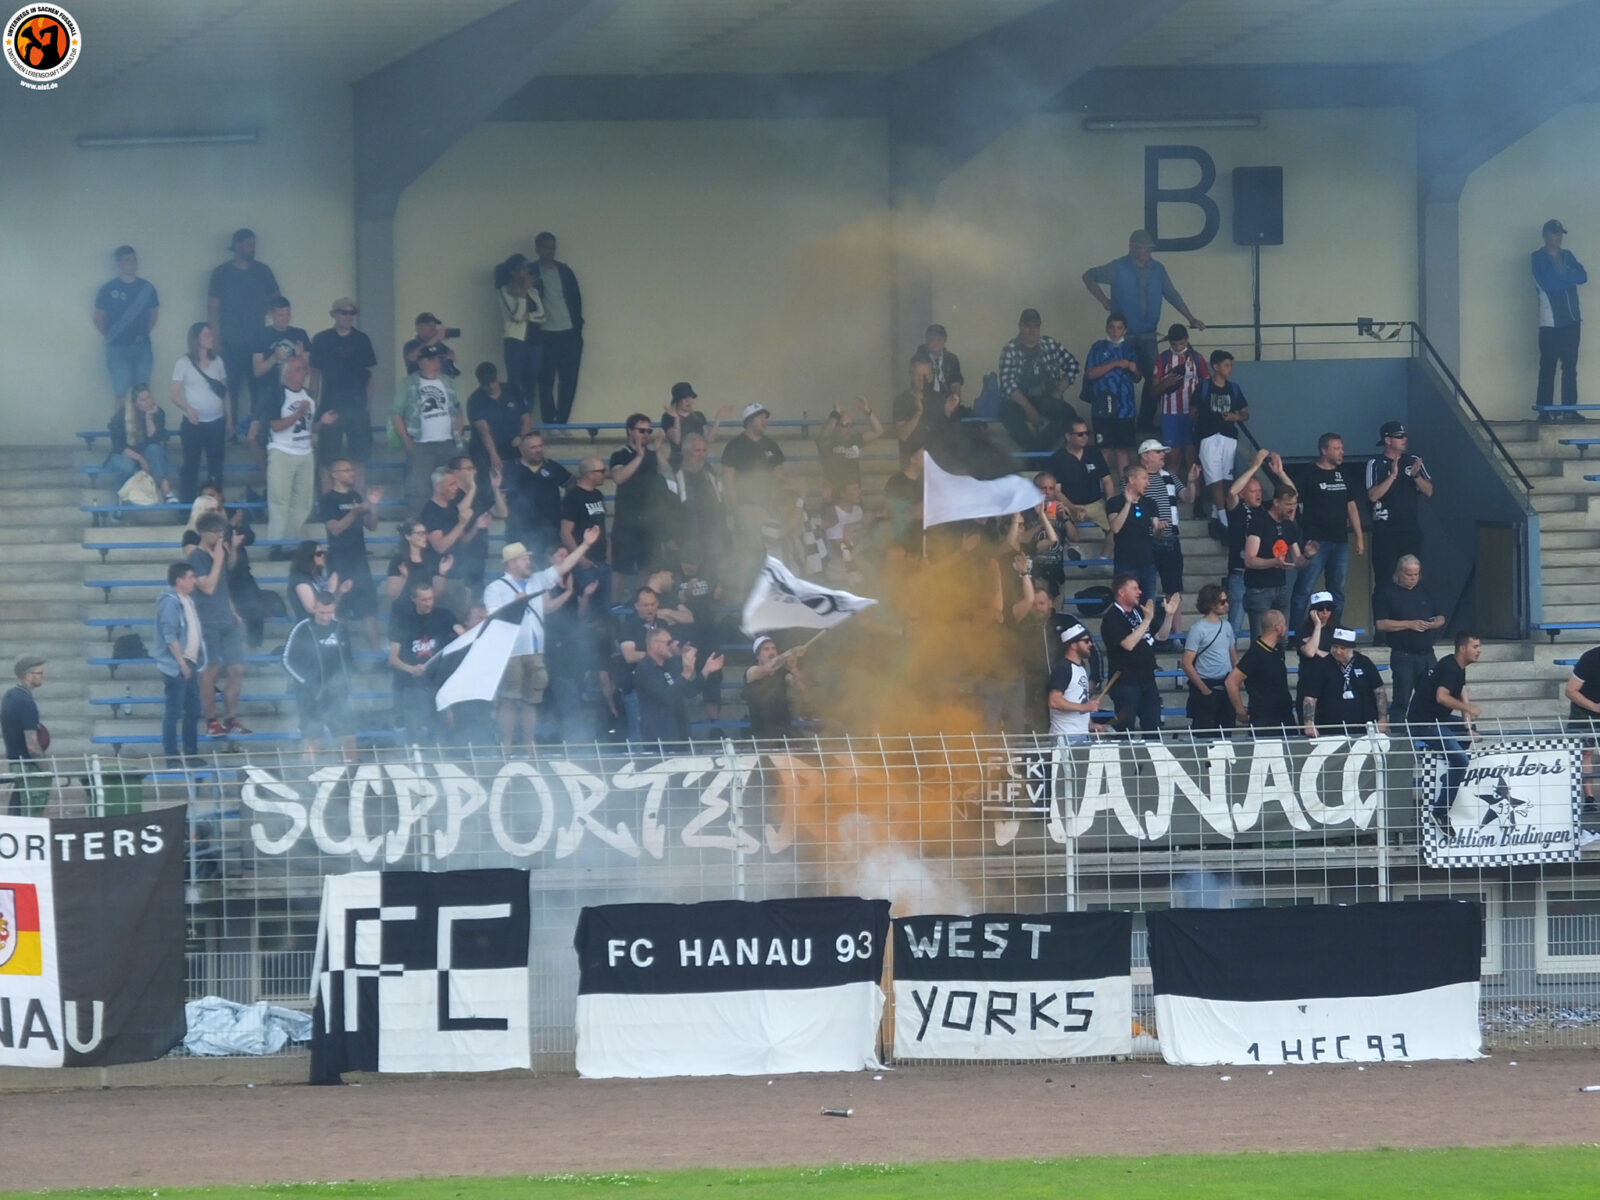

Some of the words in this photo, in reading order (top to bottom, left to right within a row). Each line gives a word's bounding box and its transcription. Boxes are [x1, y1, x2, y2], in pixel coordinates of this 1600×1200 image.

[1144, 145, 1220, 252] B
[986, 756, 1045, 779] FCK
[1448, 755, 1566, 787] pporters
[986, 783, 1045, 804] HFV
[1500, 824, 1572, 849] Büdingen
[608, 939, 654, 967] FC
[679, 938, 812, 967] HANAU
[835, 931, 873, 963] 93
[904, 921, 1051, 959] WEST
[911, 986, 1095, 1041] YORKS
[1247, 1043, 1260, 1061] 1
